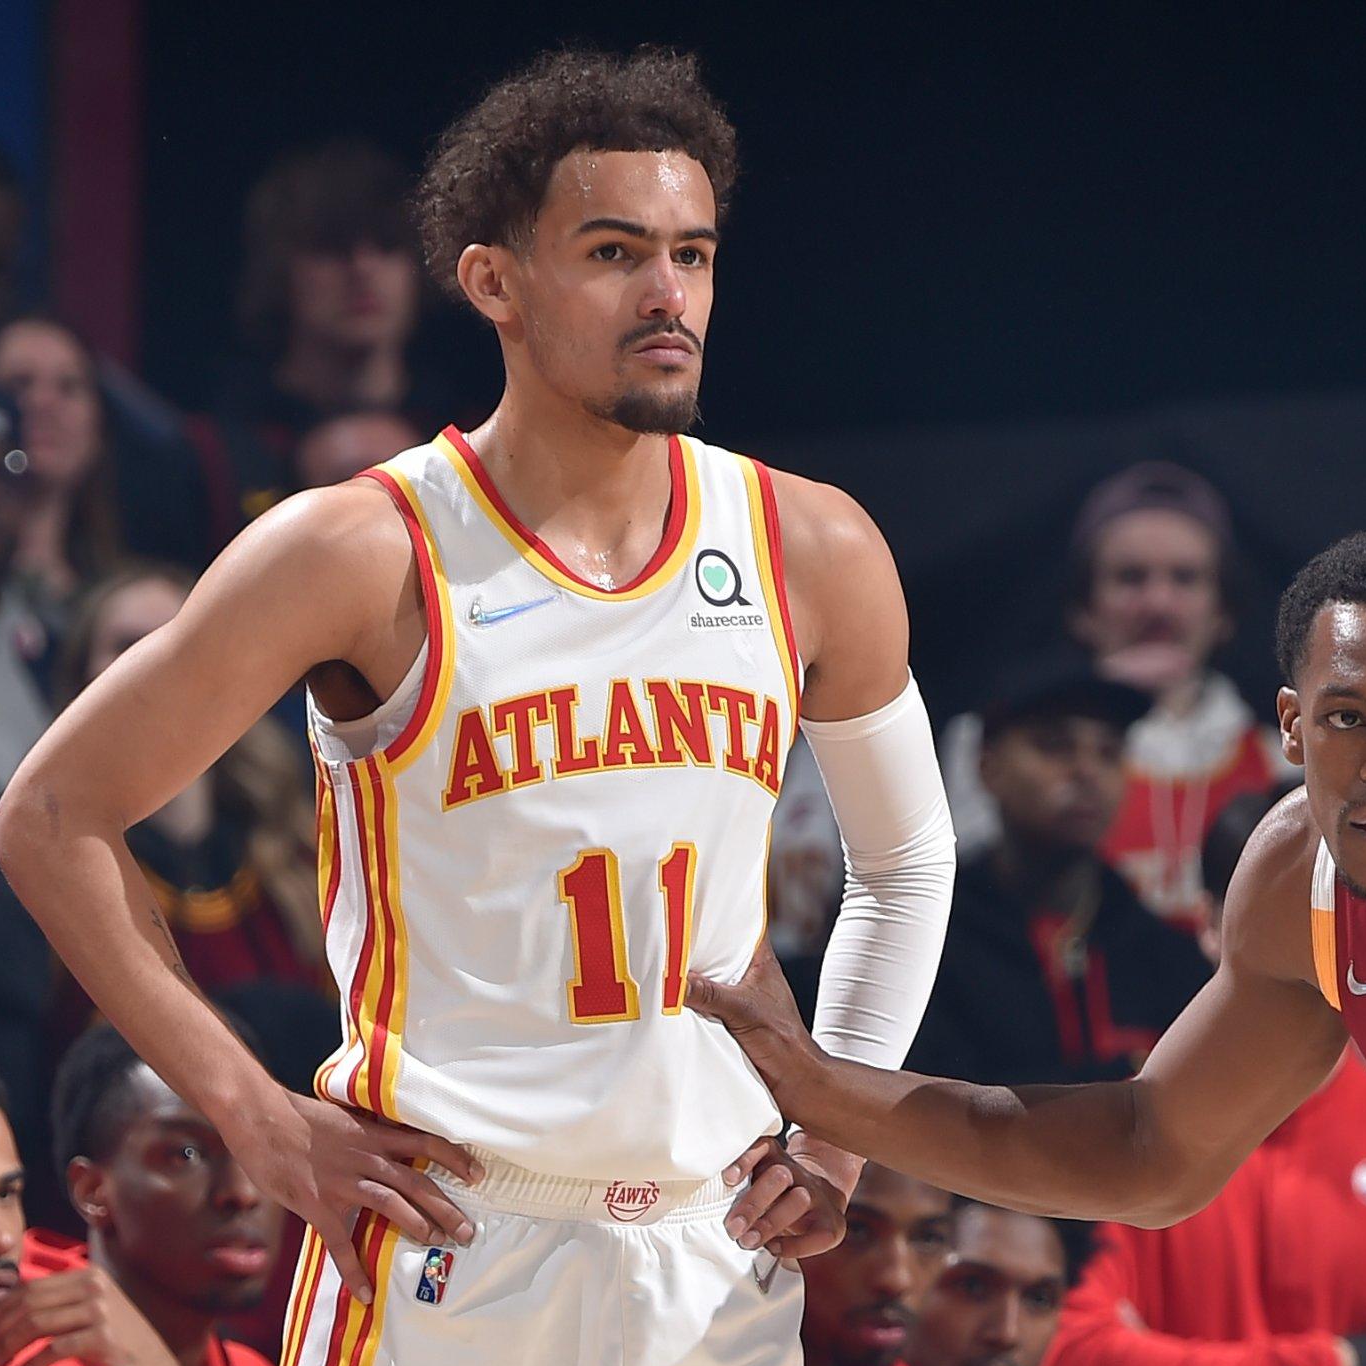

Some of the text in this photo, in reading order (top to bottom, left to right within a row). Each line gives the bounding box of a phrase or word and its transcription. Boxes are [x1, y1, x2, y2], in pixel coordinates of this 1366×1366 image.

[690, 612, 764, 628] sharecare
[441, 678, 782, 812] ATLANTA
[557, 841, 698, 1024] 11
[602, 1186, 661, 1205] HAWKS
[418, 1286, 432, 1300] 75
